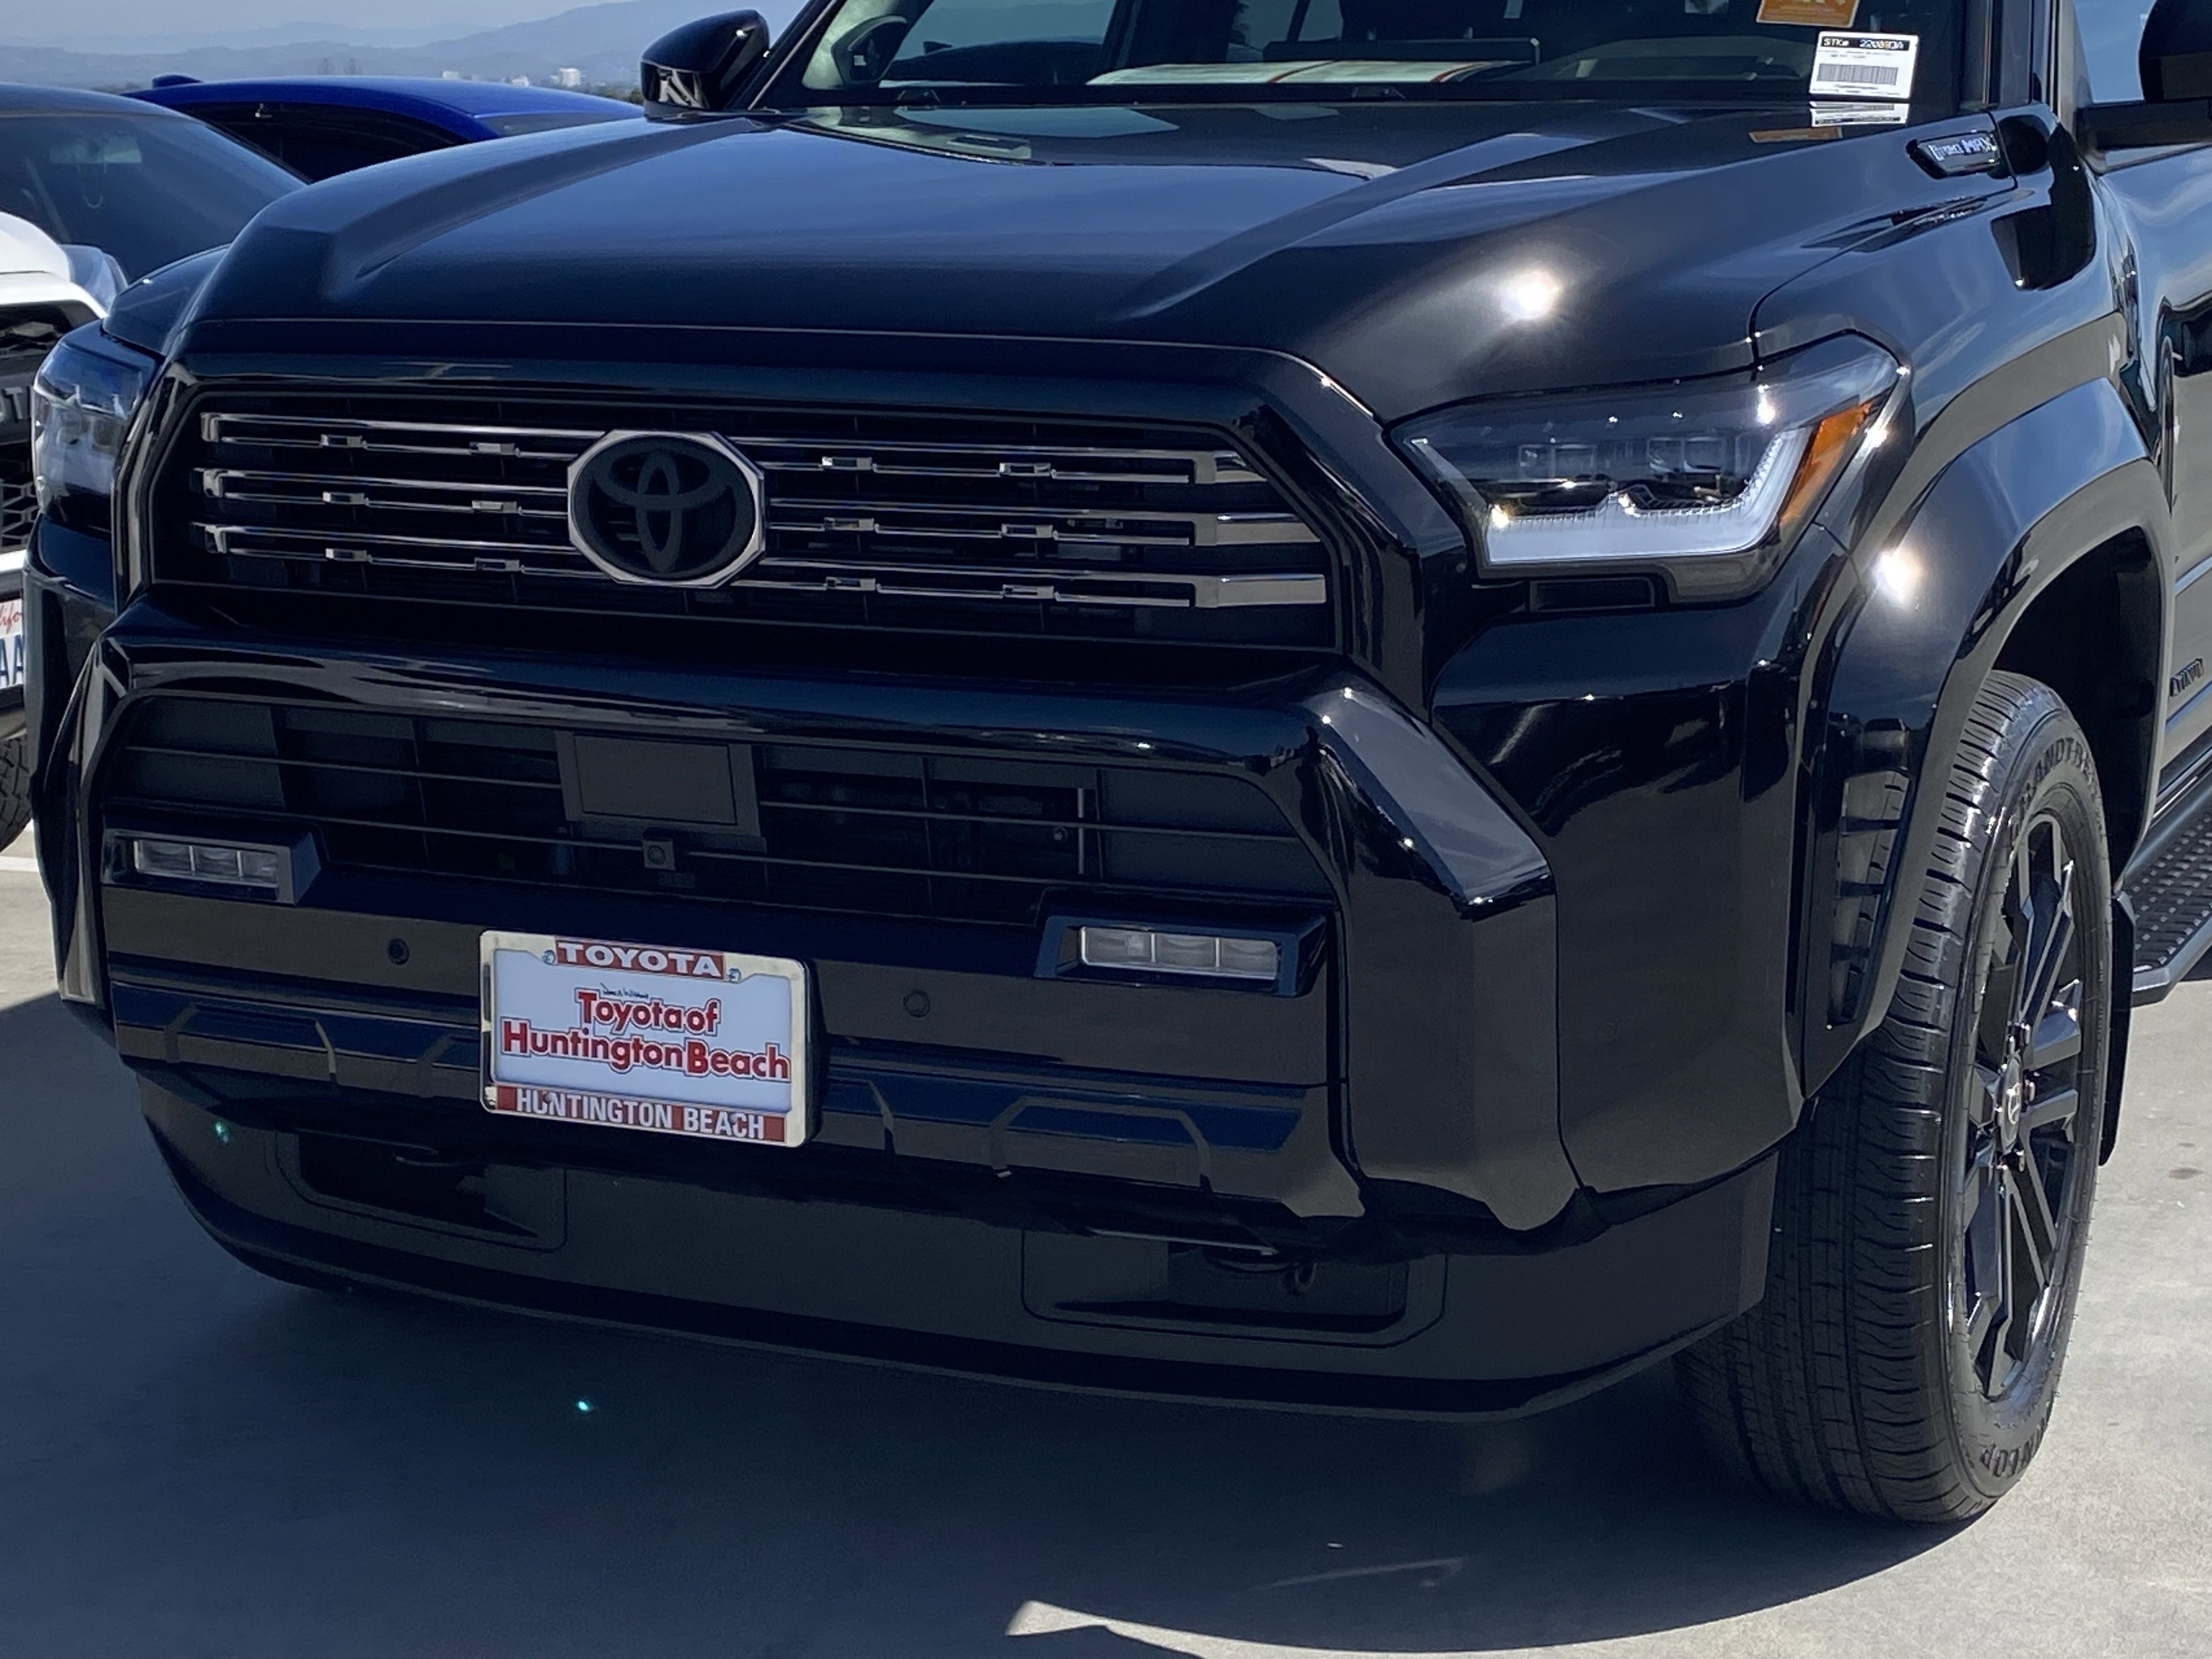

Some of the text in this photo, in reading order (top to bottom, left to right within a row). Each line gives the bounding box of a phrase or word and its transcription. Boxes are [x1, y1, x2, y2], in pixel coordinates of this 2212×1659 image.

[557, 942, 721, 978] TOYOTA
[577, 990, 684, 1033] Toyota
[685, 1000, 719, 1034] of
[503, 1020, 791, 1080] Huntington Beach
[516, 1088, 764, 1139] HUNTINGTON BEACH
